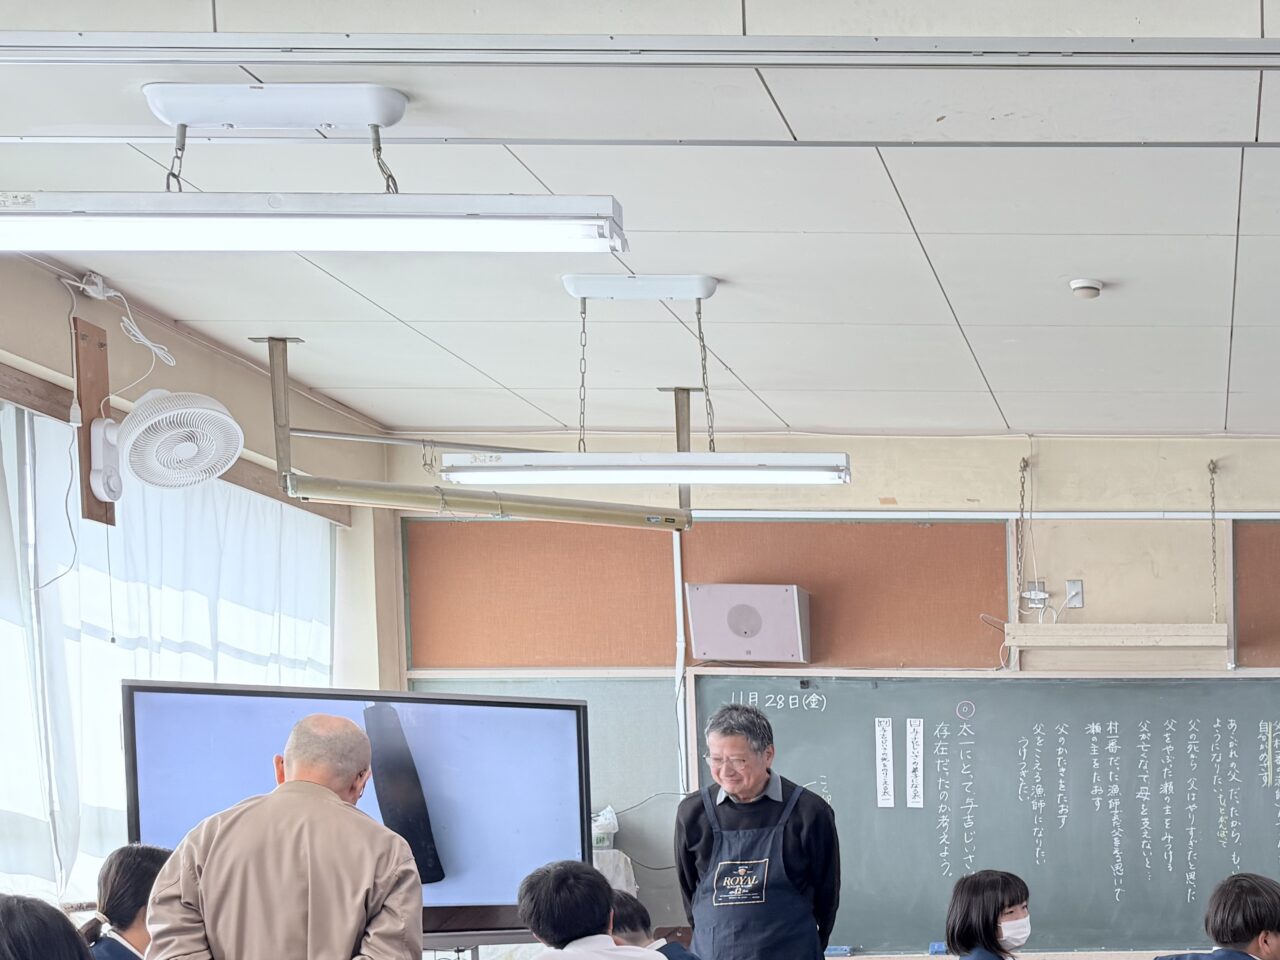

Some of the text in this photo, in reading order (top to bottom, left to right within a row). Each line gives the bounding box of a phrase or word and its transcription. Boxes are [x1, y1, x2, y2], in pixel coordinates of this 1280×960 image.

[957, 722, 979, 877] 太一にとって、与吉じいさ
[723, 875, 759, 887] ROYAL
